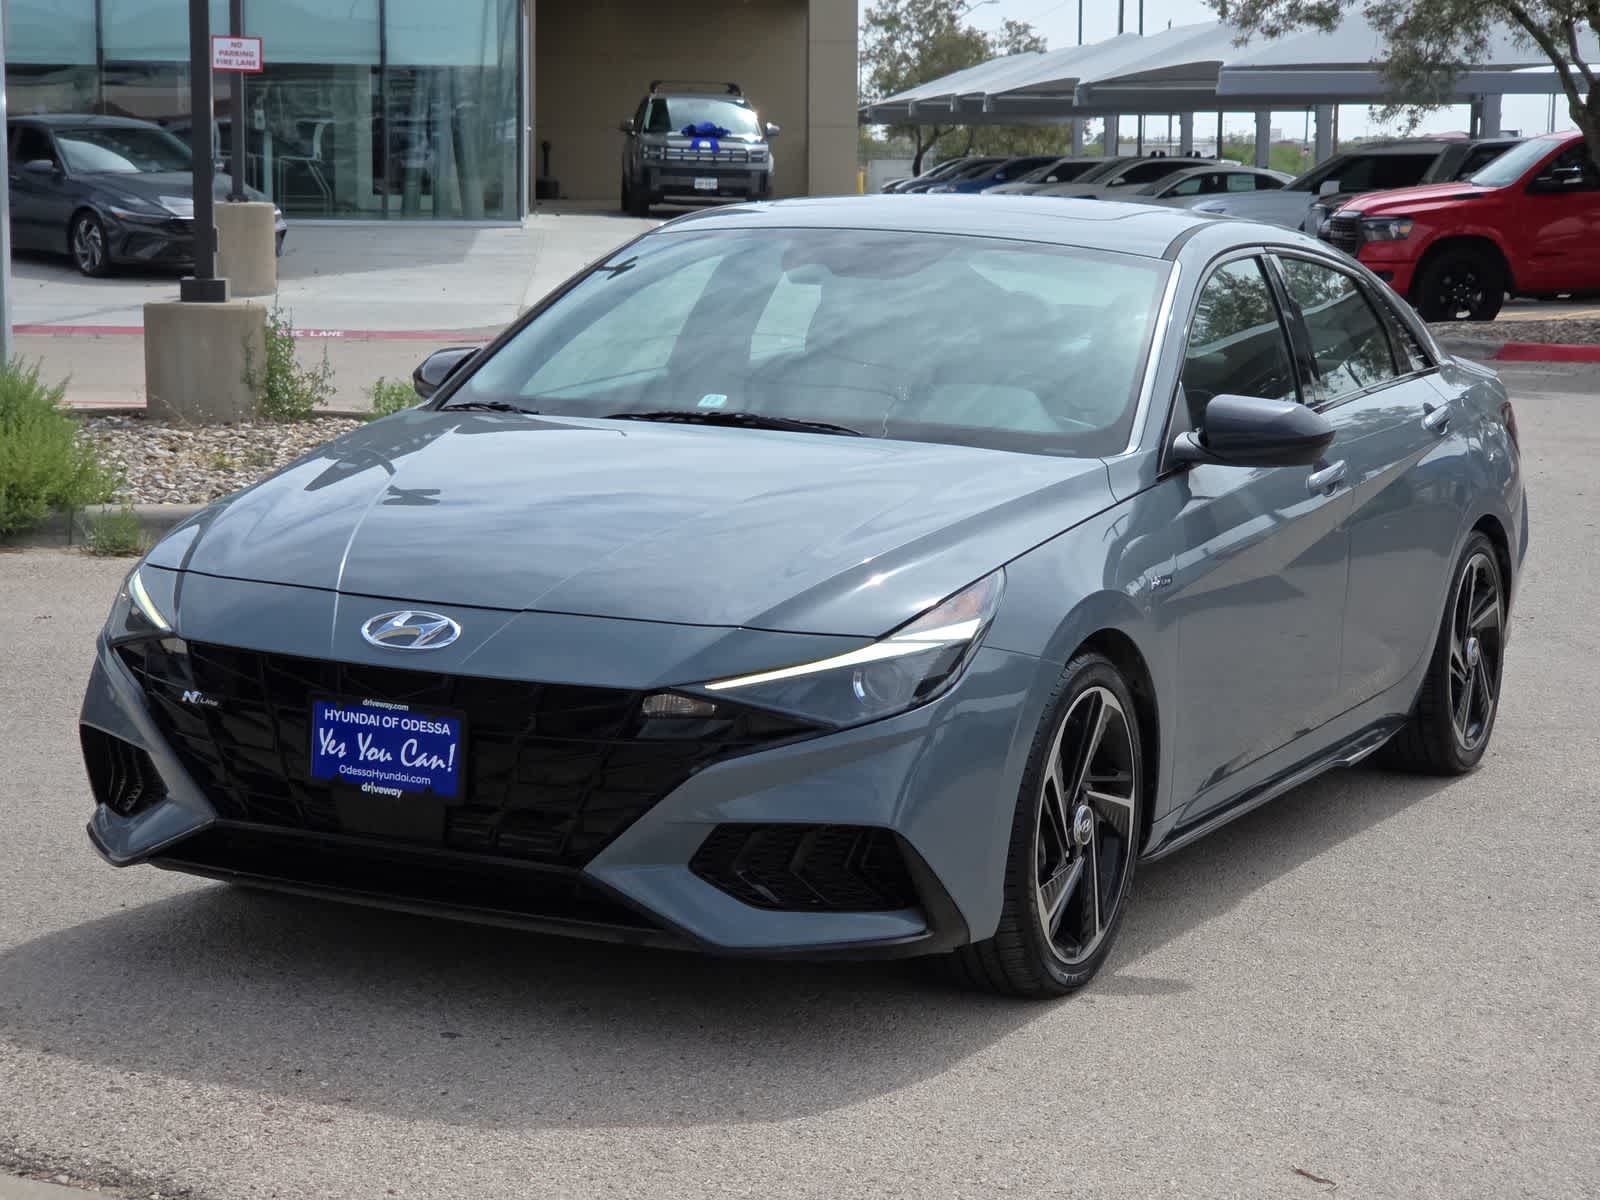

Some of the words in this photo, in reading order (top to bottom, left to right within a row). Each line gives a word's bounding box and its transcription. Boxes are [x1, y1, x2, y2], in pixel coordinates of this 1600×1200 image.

[230, 41, 243, 49] NO
[236, 59, 257, 67] LANE
[362, 698, 409, 711] driveway.com
[324, 708, 379, 727] HYUNDAI
[382, 716, 399, 729] OF
[401, 718, 451, 736] ODESSA
[319, 727, 347, 758] Yes
[357, 732, 393, 761] You
[400, 738, 456, 772] Can!
[339, 764, 431, 785] OdessaHyundai.com
[361, 781, 403, 799] driveway
